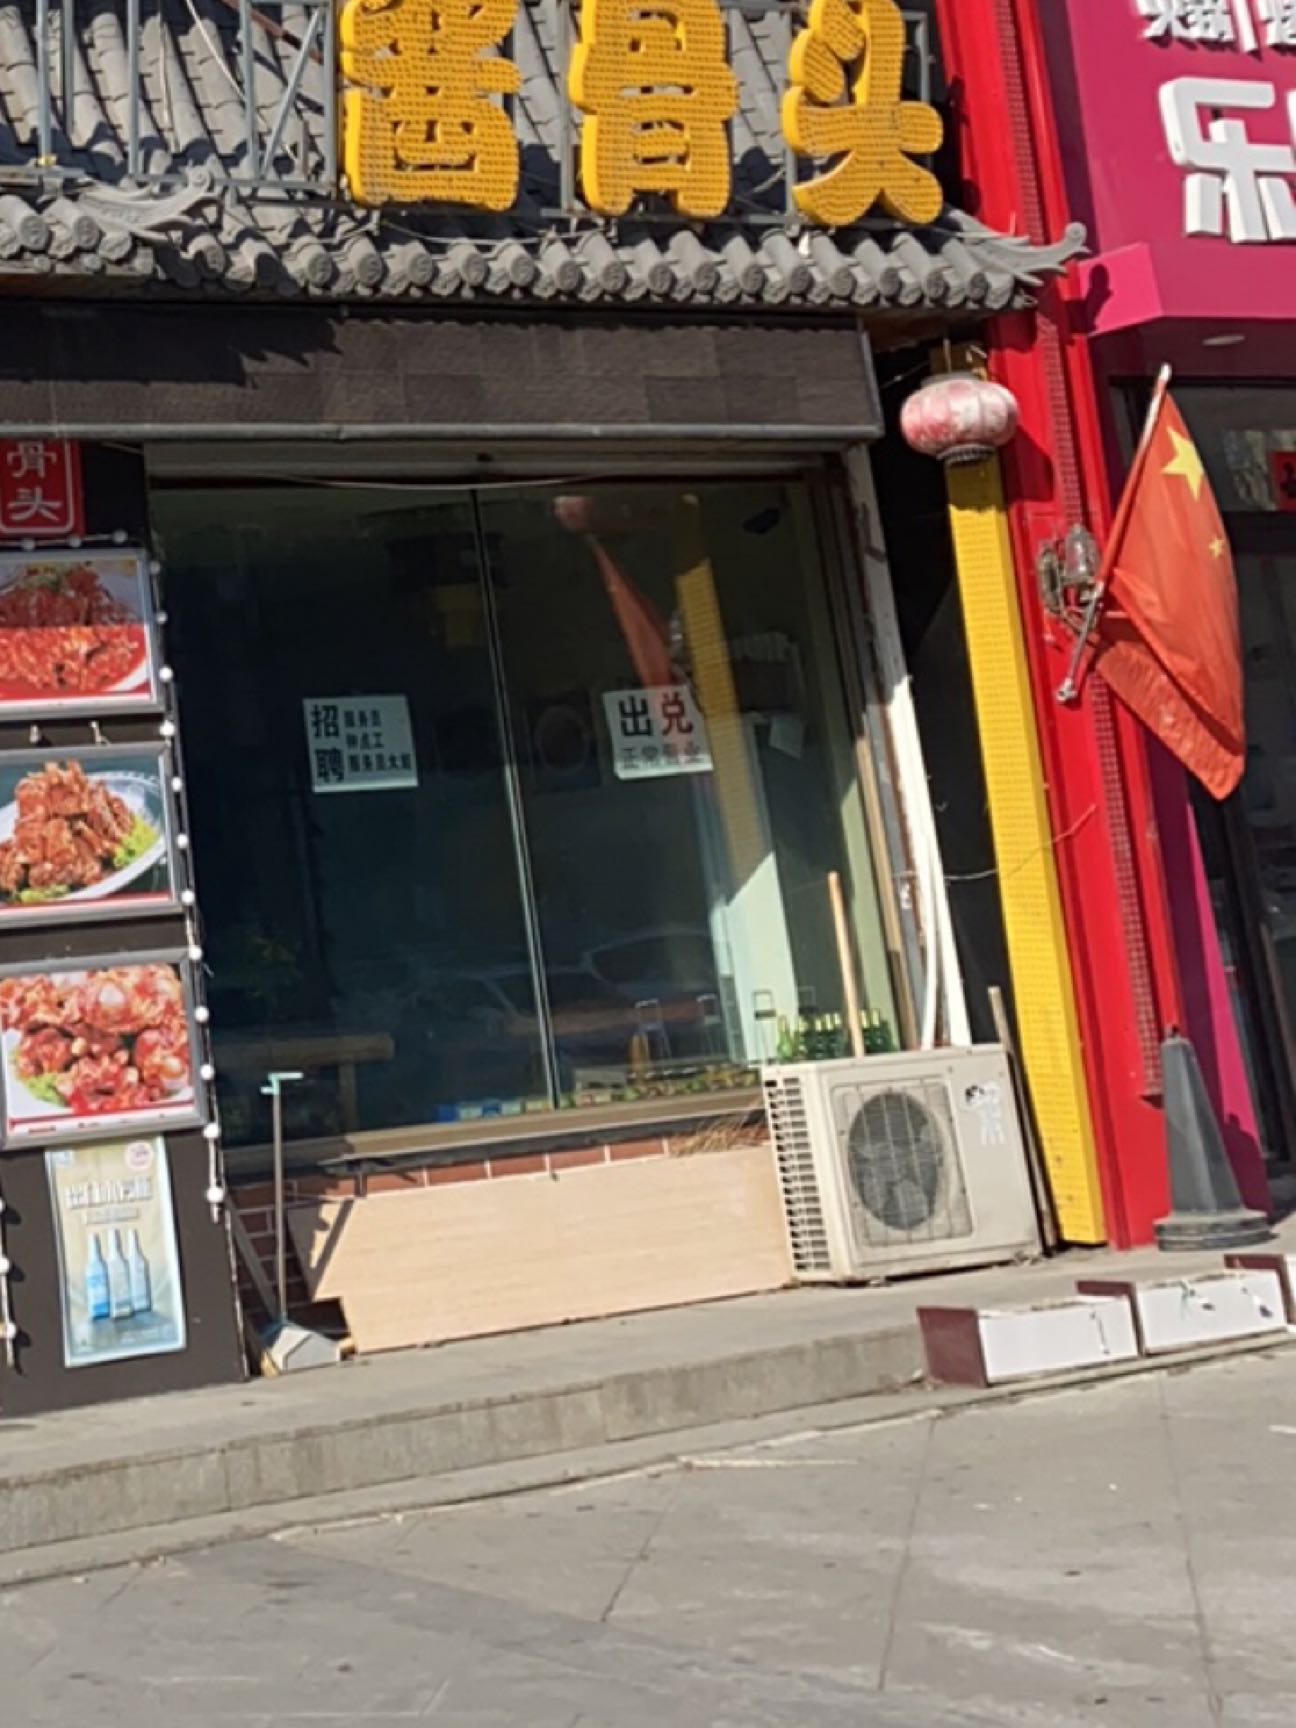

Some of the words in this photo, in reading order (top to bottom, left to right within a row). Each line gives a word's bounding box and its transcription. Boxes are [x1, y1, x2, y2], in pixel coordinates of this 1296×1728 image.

[1159, 76, 1296, 244] 乐
[6, 439, 63, 522] 骨头
[310, 703, 345, 783] 招聘
[618, 692, 694, 737] 出兑
